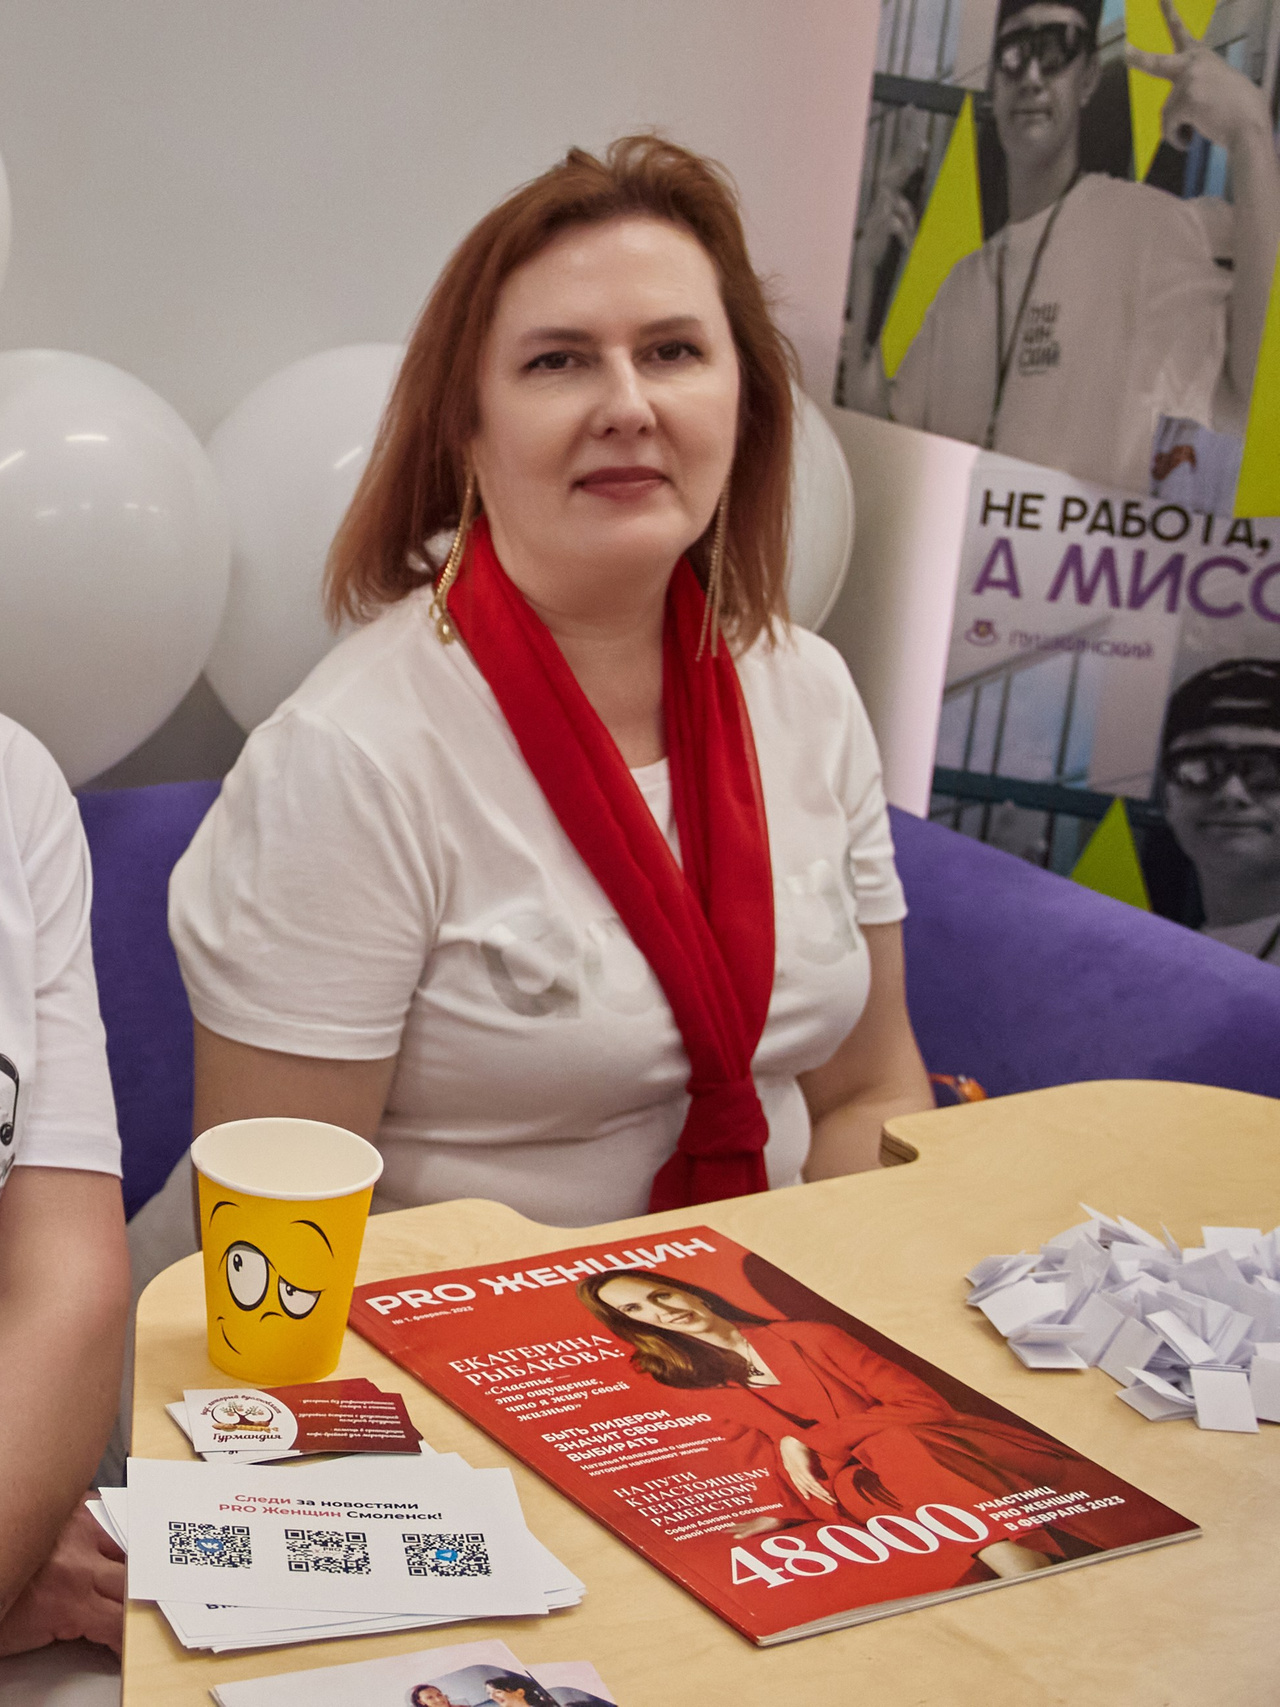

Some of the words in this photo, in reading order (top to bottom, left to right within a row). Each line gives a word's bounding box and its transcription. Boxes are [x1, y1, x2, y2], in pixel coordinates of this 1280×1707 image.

[979, 489, 1046, 532] НЕ
[1058, 496, 1272, 555] РАБОТА,
[972, 537, 1023, 599] А
[365, 1282, 477, 1316] PRO
[478, 1237, 718, 1297] ЖЕНЩИН
[448, 1334, 613, 1374] ЕКАТЕРИНА
[464, 1348, 626, 1387] РЫБАКОВА:
[484, 1376, 554, 1397] «Счастье
[495, 1394, 525, 1406] это
[526, 1376, 604, 1399] ощущение,
[505, 1401, 537, 1414] что
[539, 1398, 550, 1407] я
[550, 1390, 589, 1404] живу
[591, 1380, 631, 1396] своей
[516, 1402, 582, 1423] жизнью»
[541, 1427, 590, 1443] БЫТЬ
[589, 1409, 671, 1433] ЛИДЕРОМ
[213, 1433, 283, 1443] Гурмандия
[553, 1430, 622, 1453] ЗНАЧИТ
[622, 1413, 712, 1438] СВОБОДНО
[566, 1436, 659, 1463] ВЫБИРАТЬ
[588, 1463, 629, 1477] которые
[612, 1485, 646, 1499] НА
[643, 1471, 698, 1492] ПУТИ
[234, 1494, 292, 1505] Следи
[296, 1498, 316, 1507] за
[321, 1499, 419, 1510] новостями
[625, 1498, 643, 1508] К
[641, 1467, 771, 1505] НАСТОЯЩЕМУ
[637, 1481, 759, 1518] ГЕНДЕРНОМУ
[973, 1485, 1057, 1512] УЧАСТНИЦ
[218, 1503, 257, 1514] PRO
[262, 1506, 342, 1519] Женщин
[346, 1510, 443, 1521] Смоленск!
[650, 1494, 754, 1527] РАВЕНСТВУ
[988, 1507, 1021, 1522] PRO
[1020, 1490, 1091, 1514] ЖЕНЩИН
[1003, 1521, 1019, 1532] В
[1018, 1504, 1089, 1528] ФЕВРАЛЕ
[1085, 1495, 1126, 1511] 2023
[664, 1522, 697, 1536] София
[673, 1529, 704, 1542] новой
[729, 1502, 990, 1590] 48000
